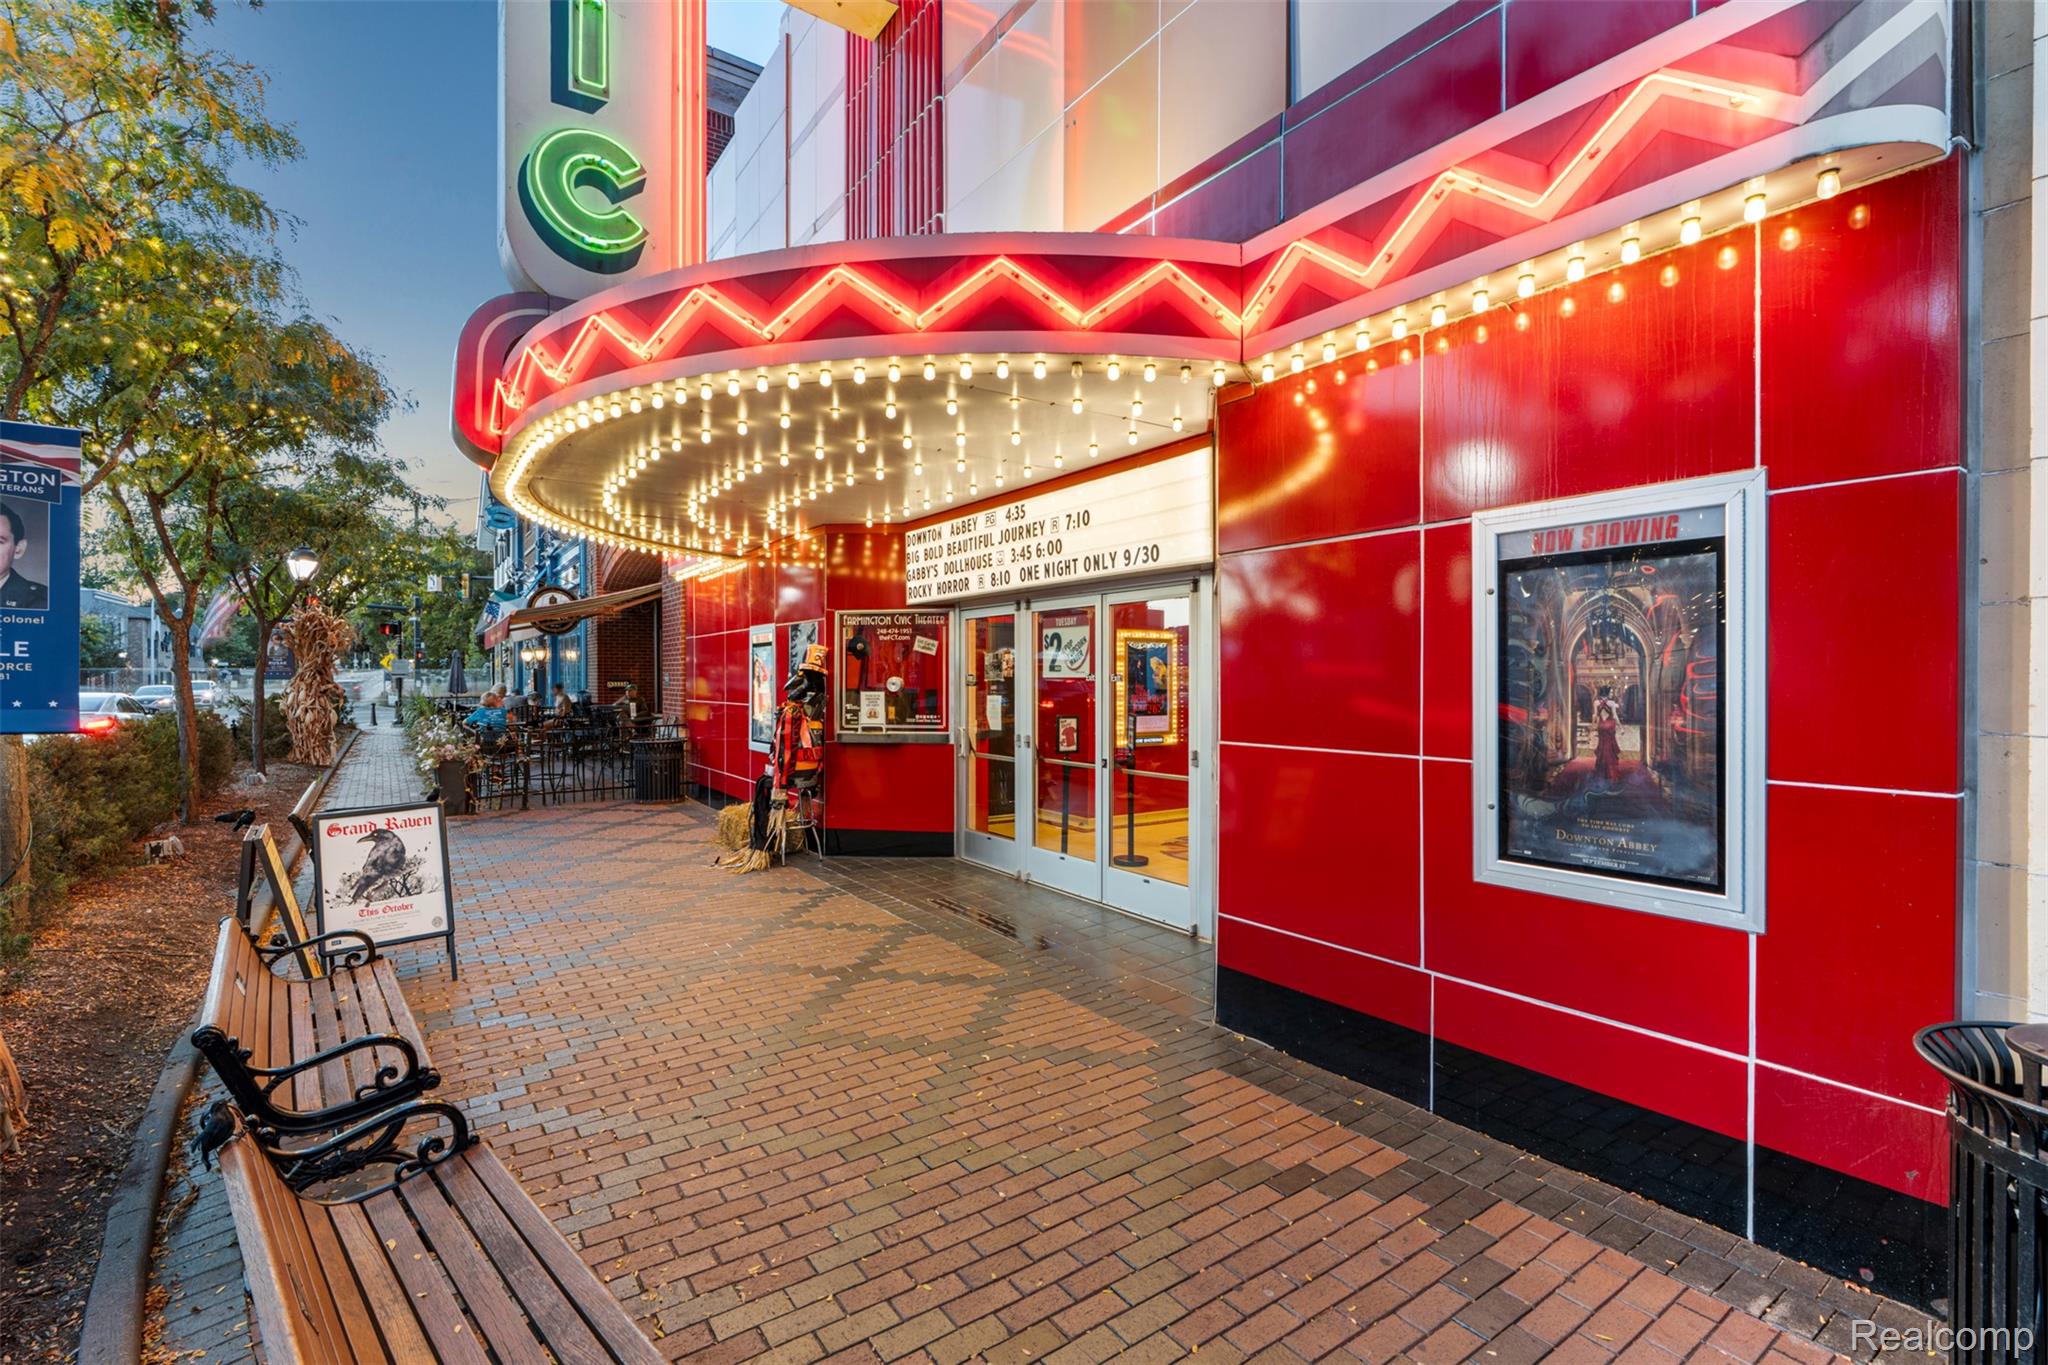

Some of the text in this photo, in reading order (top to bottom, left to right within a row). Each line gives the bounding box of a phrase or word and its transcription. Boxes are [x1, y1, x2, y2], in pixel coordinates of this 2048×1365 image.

[906, 550, 920, 565] BIG
[924, 545, 944, 561] BOLD
[947, 532, 995, 556] BEAUTIFUL
[998, 520, 1046, 545] JOURNEY
[1065, 509, 1091, 530] 7:10
[907, 526, 942, 547] DOWNTON
[950, 516, 978, 537] ABBEY
[1005, 504, 1026, 523] 4:35
[1532, 514, 1680, 555] NOW SHOWING
[906, 564, 938, 582] GABBY'S
[944, 552, 993, 575] DOLLHOUSE
[1011, 545, 1032, 563] 3:45
[1036, 538, 1063, 558] 6:00
[908, 583, 932, 600] ROCKY
[937, 577, 970, 595] HORROR
[990, 570, 1011, 587] 8:10
[1019, 564, 1040, 582] ONE
[1044, 558, 1078, 579] NIGHT
[1083, 551, 1117, 572] ONLY
[1123, 544, 1160, 567] 9/30
[843, 613, 945, 626] FARMINGTON CIVIC THEATER
[1055, 617, 1077, 627] TUESDAY
[326, 816, 432, 838] Grand Raven
[1555, 828, 1614, 846] DOWNTON
[1617, 837, 1658, 852] ABBEY
[358, 902, 415, 918] This October
